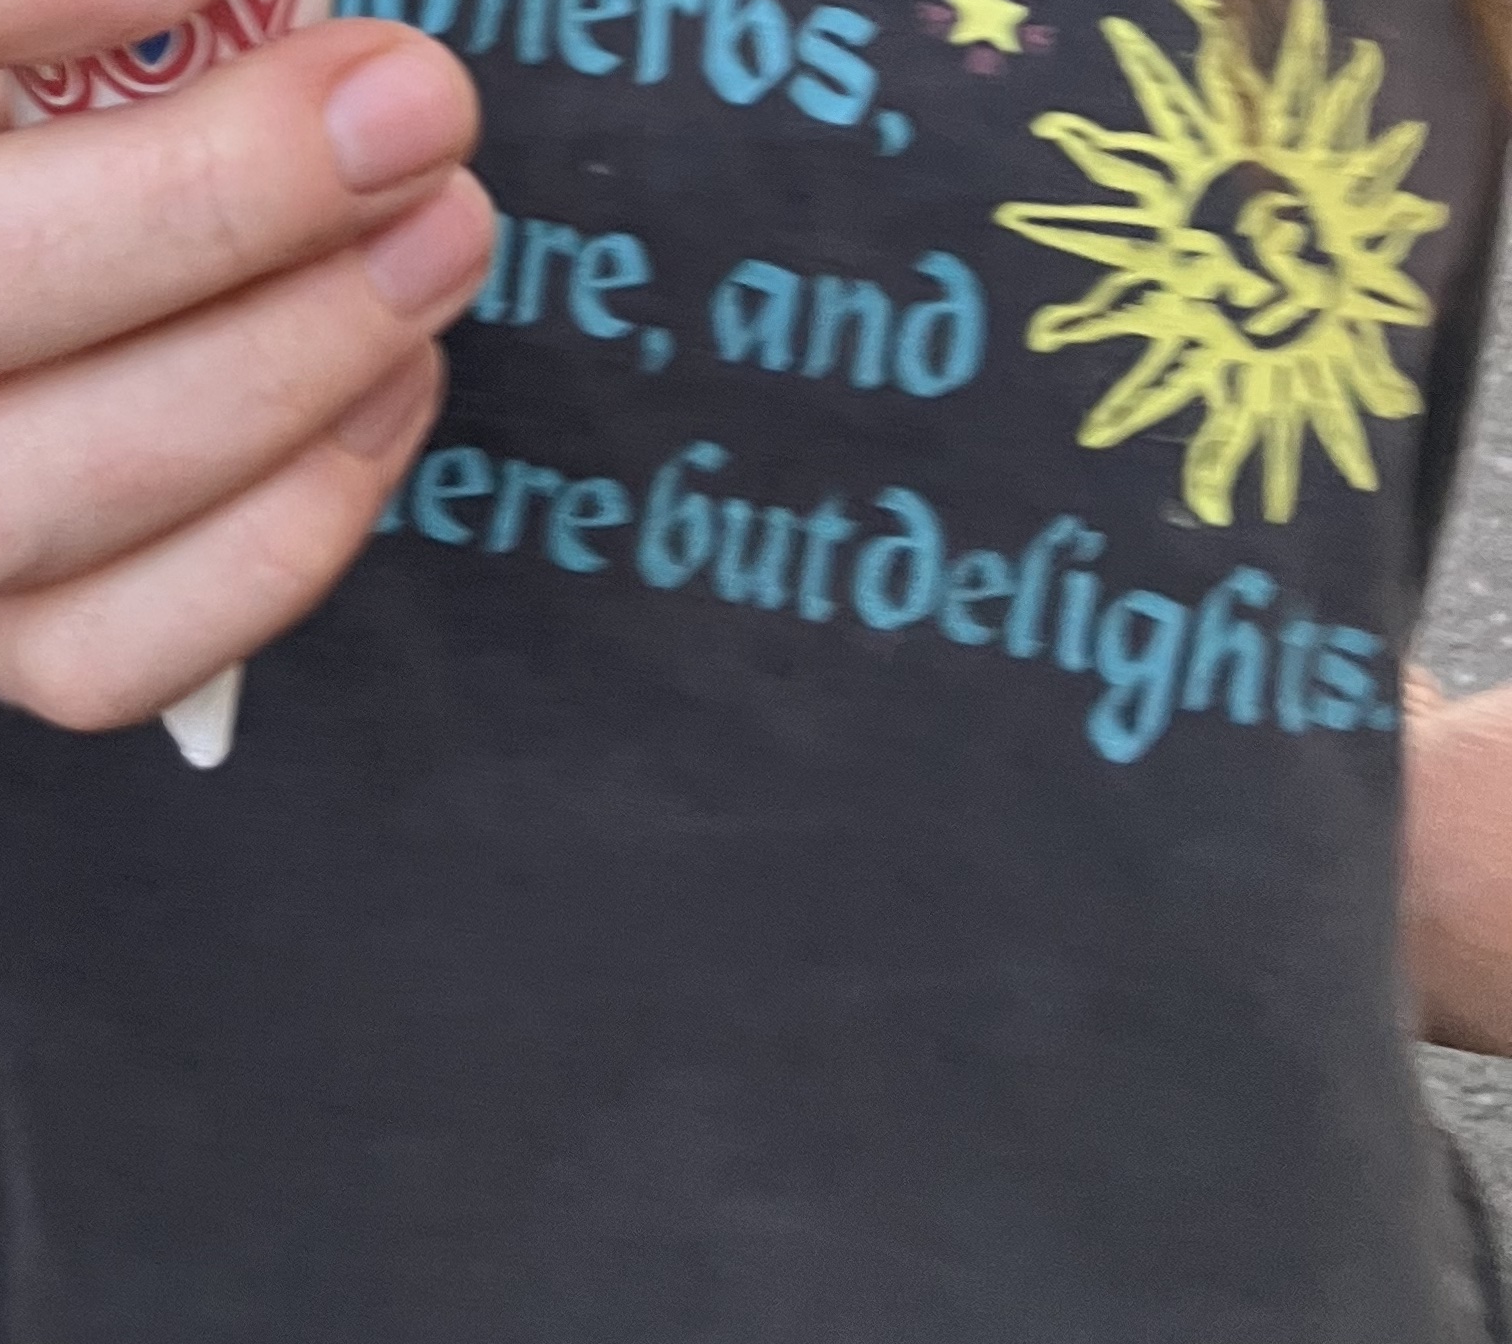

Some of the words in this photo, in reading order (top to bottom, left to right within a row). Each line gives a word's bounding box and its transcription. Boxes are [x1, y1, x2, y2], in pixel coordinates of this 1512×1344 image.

[710, 250, 984, 398] and
[372, 444, 633, 574] ere
[635, 440, 858, 624] but
[850, 486, 1398, 764] delights.
